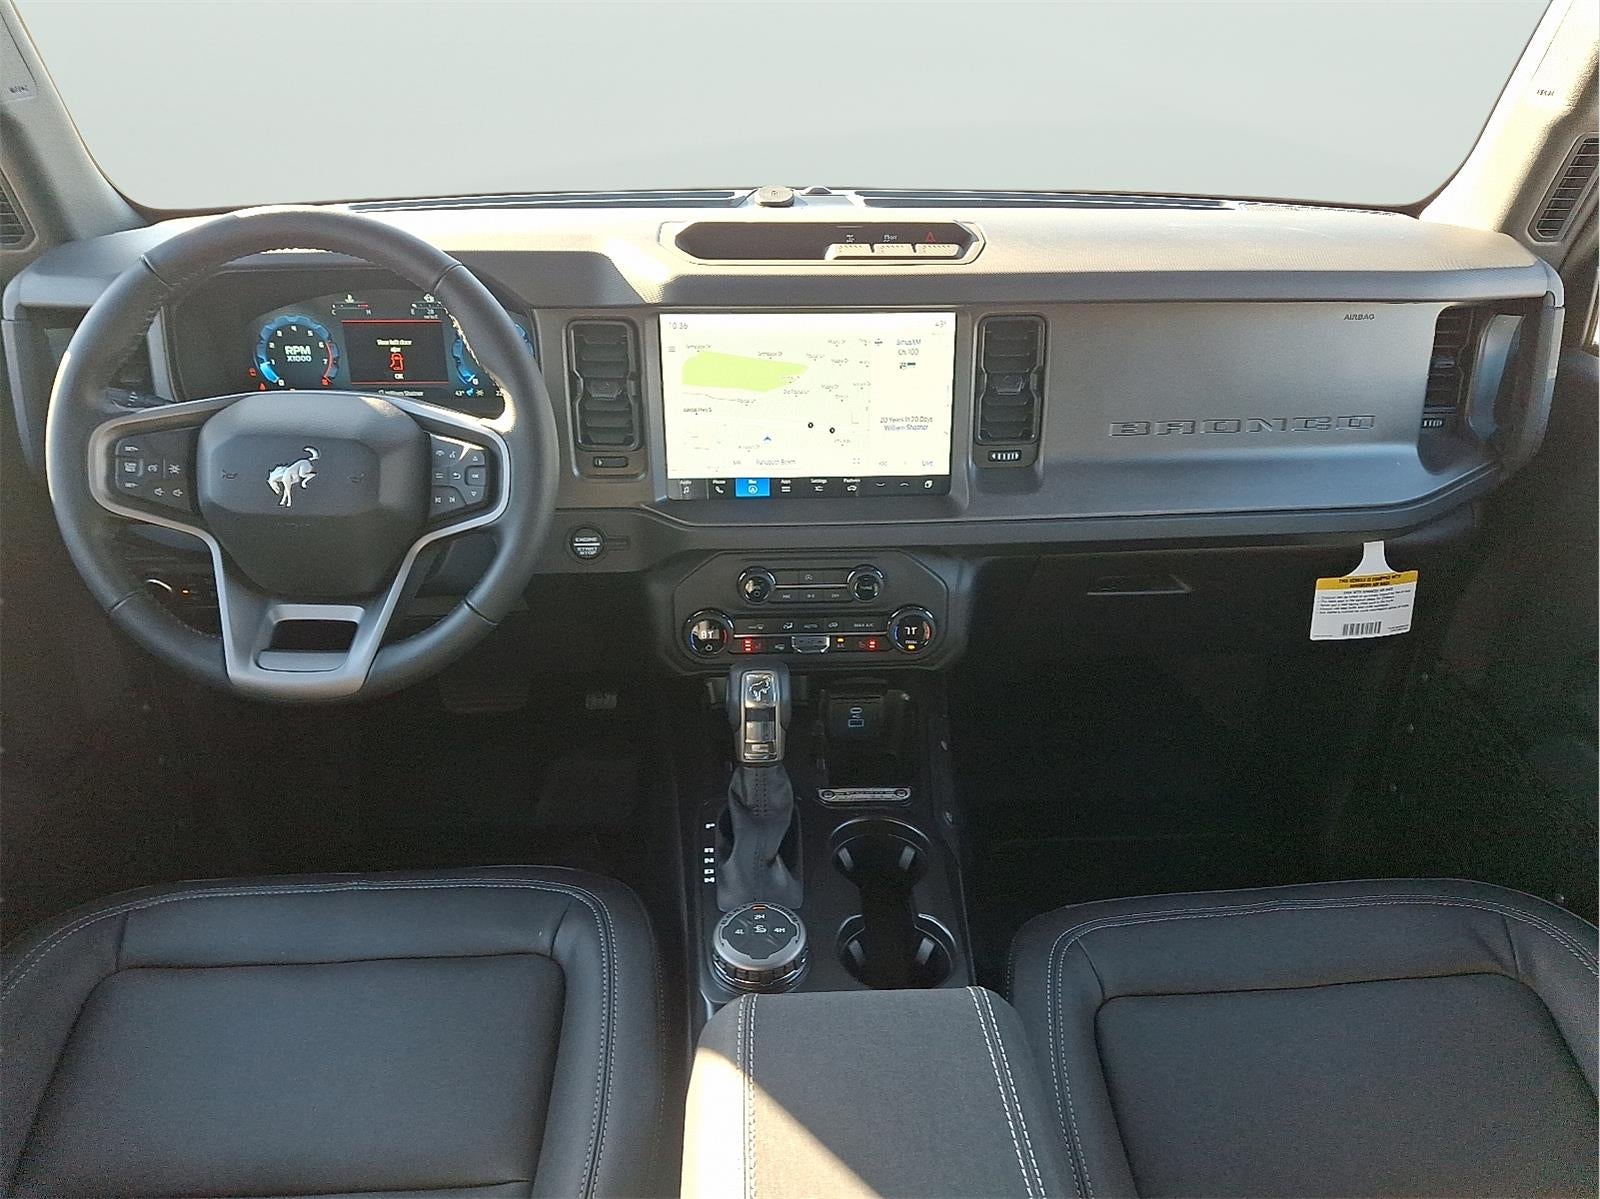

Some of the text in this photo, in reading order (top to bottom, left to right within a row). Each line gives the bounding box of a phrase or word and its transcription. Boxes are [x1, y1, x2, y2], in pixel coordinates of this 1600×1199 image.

[1344, 313, 1375, 321] AIRBAG
[284, 345, 312, 355] RPM
[1109, 414, 1376, 437] BRONCO
